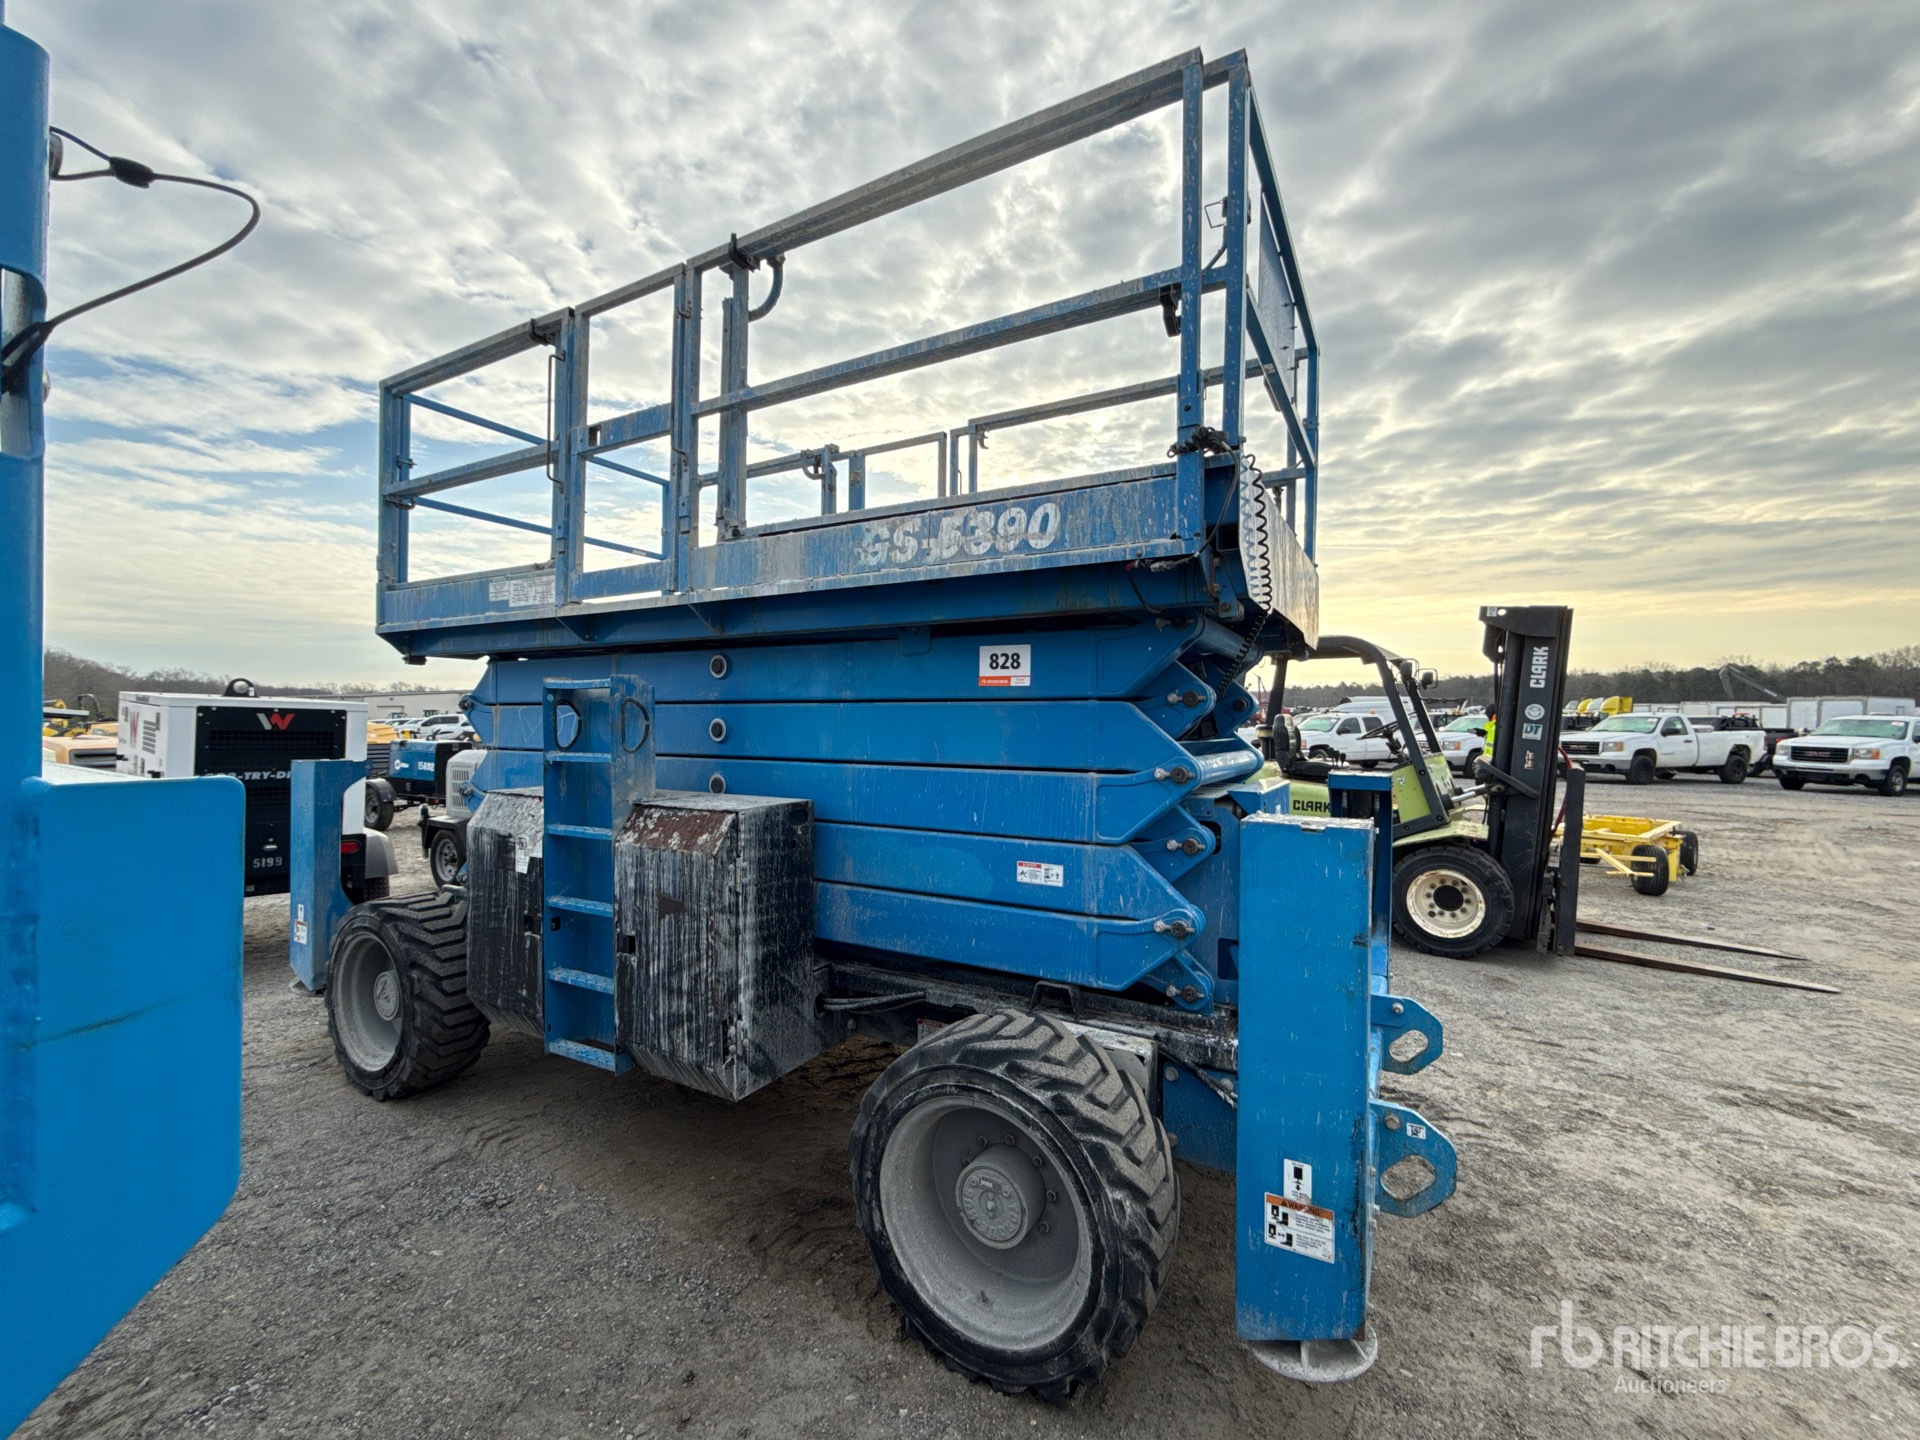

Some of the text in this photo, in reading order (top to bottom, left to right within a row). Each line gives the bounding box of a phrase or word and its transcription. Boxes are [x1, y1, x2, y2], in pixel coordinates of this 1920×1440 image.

[989, 652, 1021, 670] 828
[1529, 646, 1550, 689] CLARK
[1293, 799, 1331, 814] CLARK
[253, 856, 283, 869] 5199
